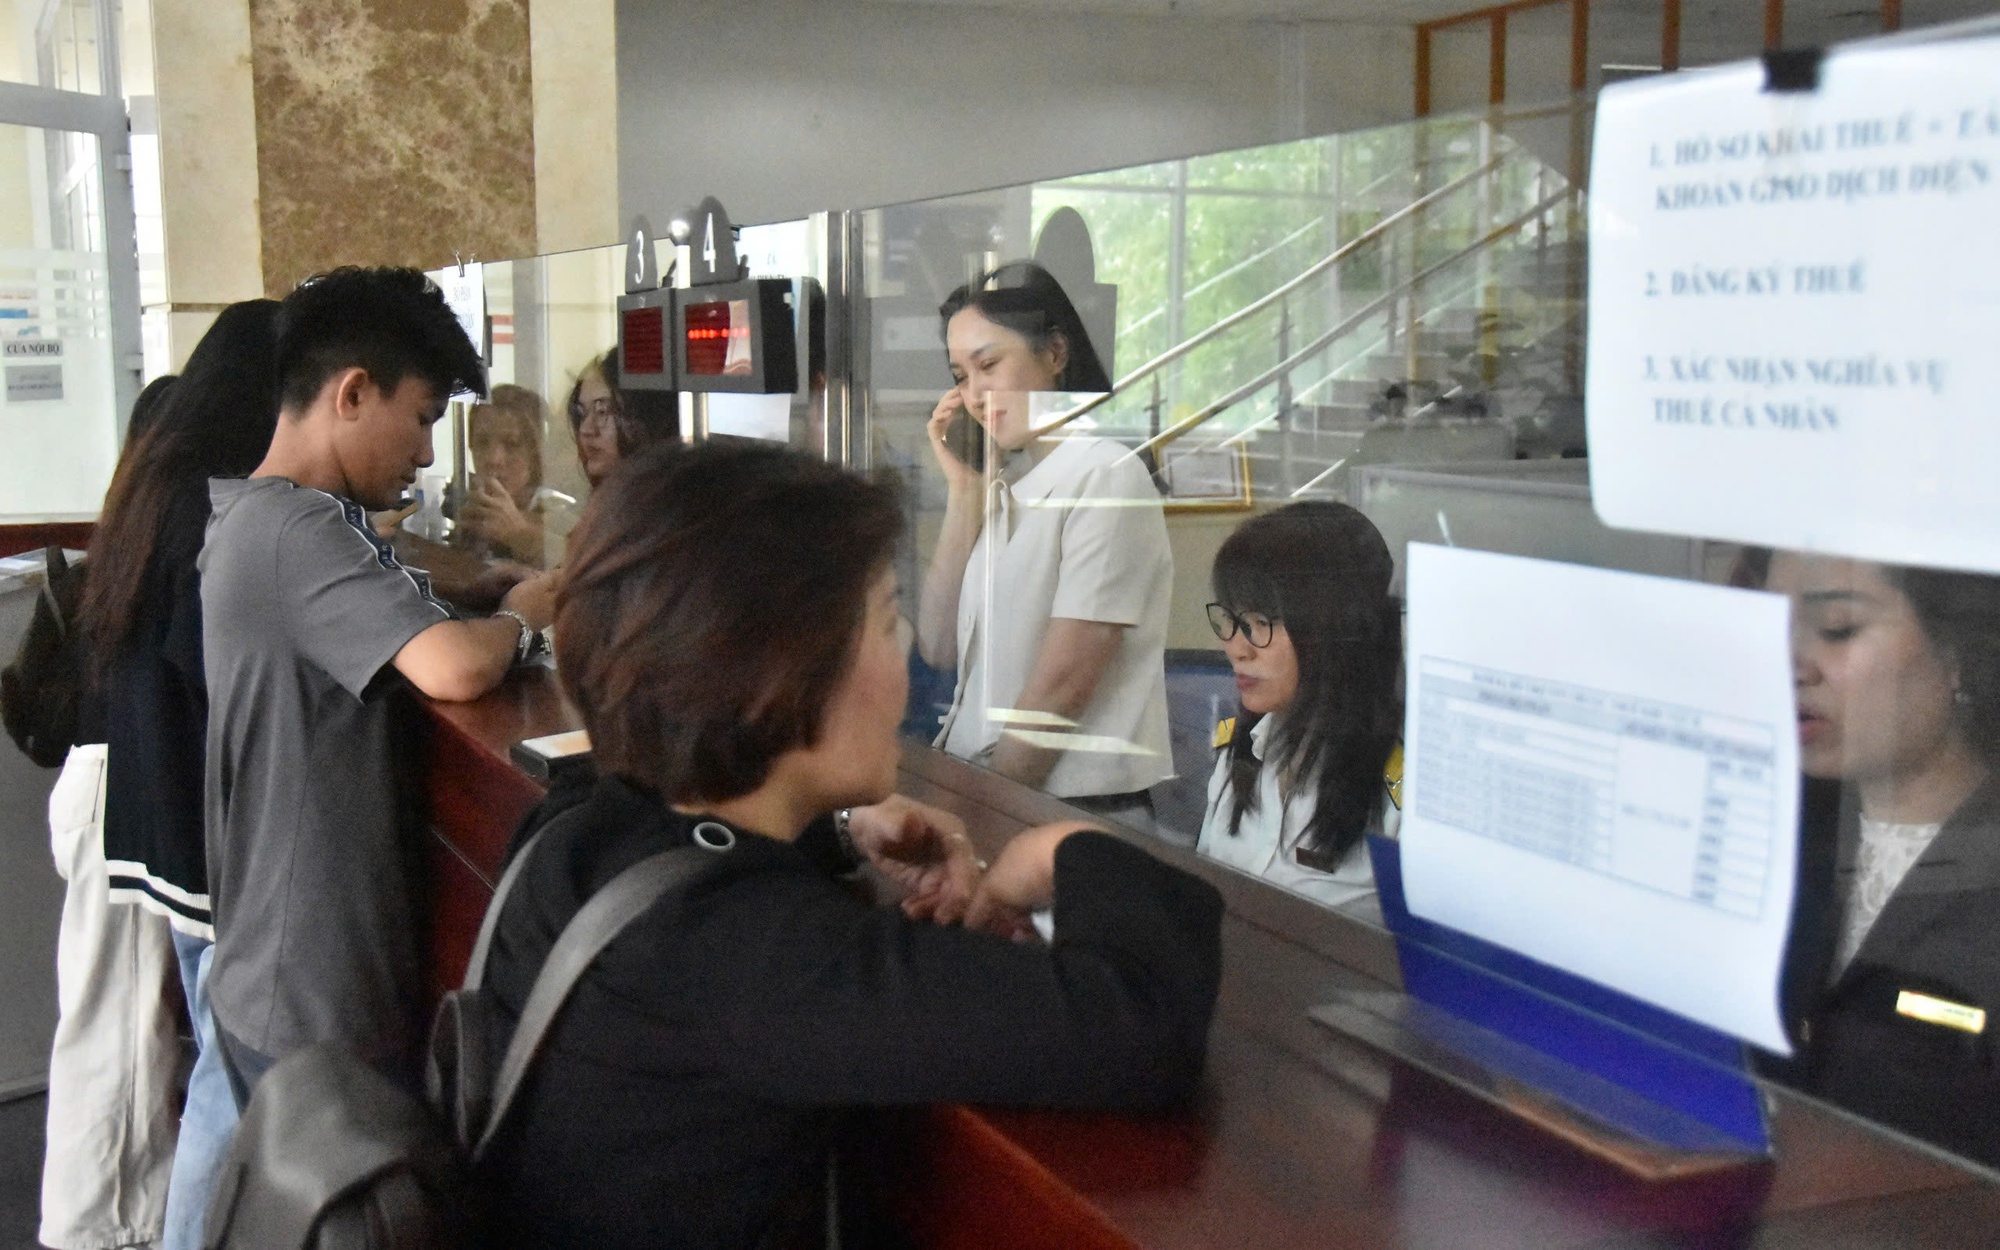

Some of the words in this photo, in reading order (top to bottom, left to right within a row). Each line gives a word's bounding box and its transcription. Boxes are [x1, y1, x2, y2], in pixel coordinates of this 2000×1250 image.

[1756, 123, 1826, 158] KHAI
[634, 230, 644, 283] 3
[703, 212, 716, 273] 4
[1644, 269, 1662, 297] 2.
